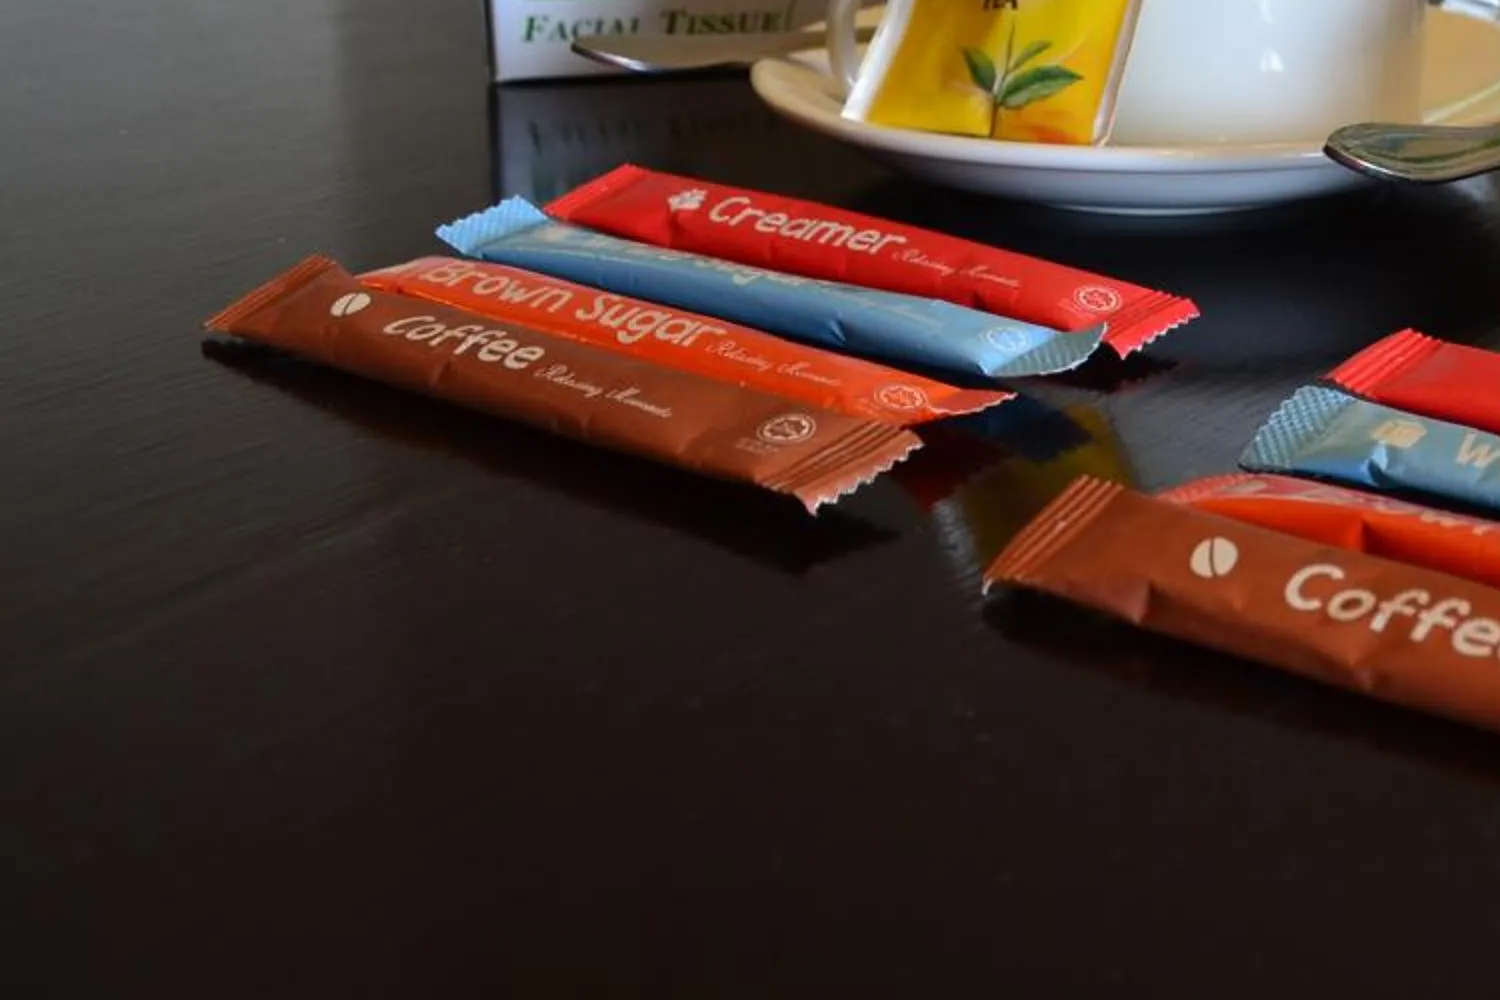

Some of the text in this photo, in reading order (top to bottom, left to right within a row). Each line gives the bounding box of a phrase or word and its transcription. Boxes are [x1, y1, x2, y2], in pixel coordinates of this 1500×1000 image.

[660, 8, 783, 37] TISSUE
[708, 195, 907, 257] Creamer
[421, 260, 573, 315] Brown
[575, 290, 724, 348] Sugar
[383, 315, 545, 371] Coffee
